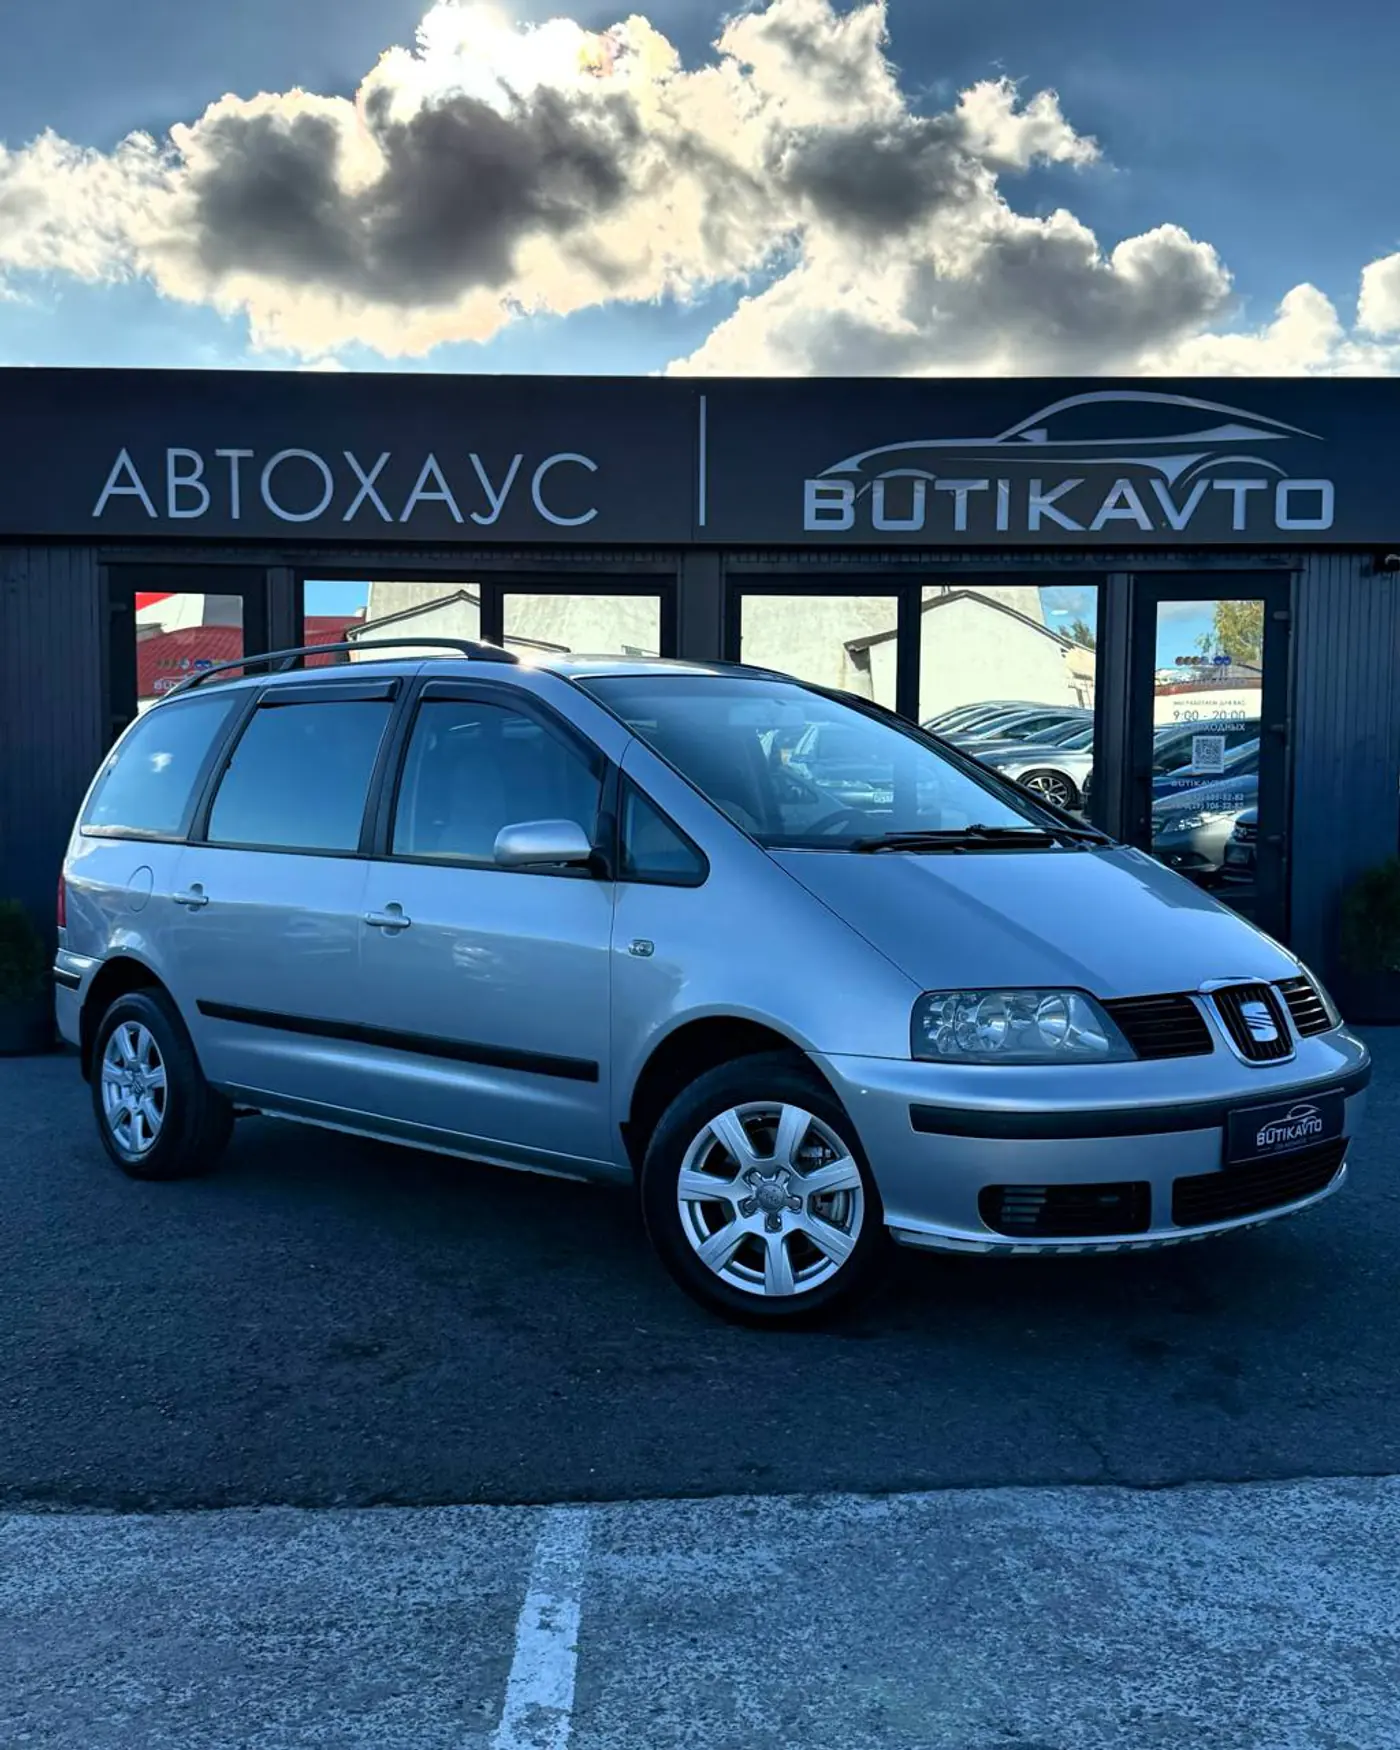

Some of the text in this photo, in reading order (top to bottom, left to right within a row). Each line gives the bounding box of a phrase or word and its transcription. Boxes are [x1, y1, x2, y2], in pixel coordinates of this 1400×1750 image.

[92, 447, 599, 526] АВТОХАУС
[803, 478, 1335, 532] BUTIKAVTO
[1173, 710, 1199, 721] 9:00
[1212, 710, 1246, 721] 20:00
[1256, 1118, 1323, 1147] BUTIKAVTO
